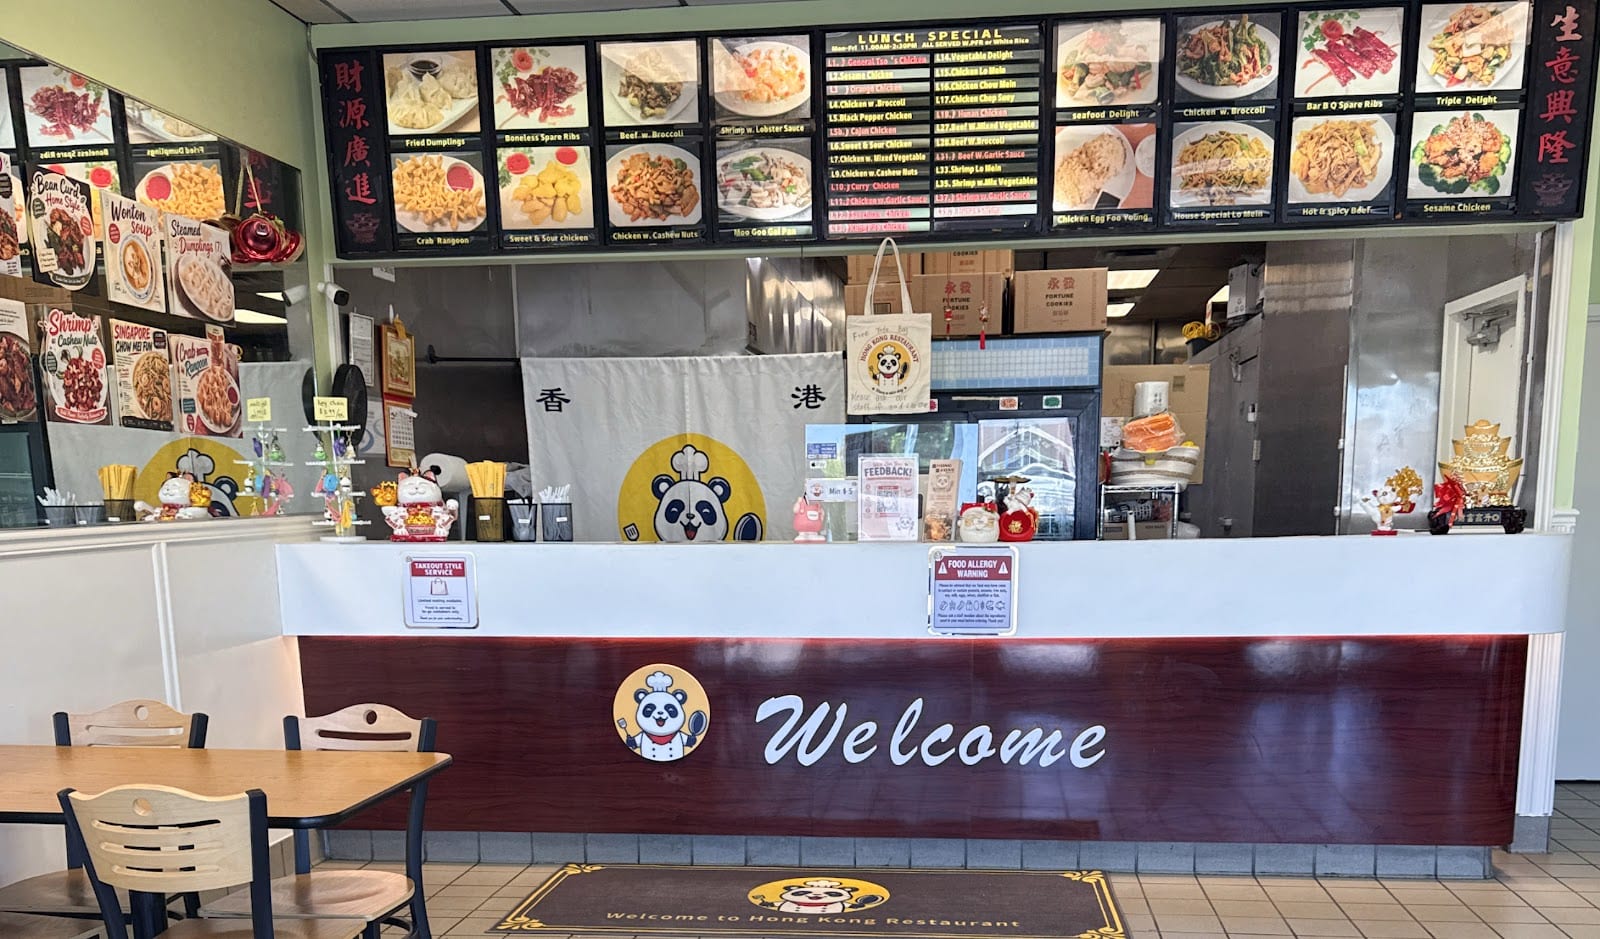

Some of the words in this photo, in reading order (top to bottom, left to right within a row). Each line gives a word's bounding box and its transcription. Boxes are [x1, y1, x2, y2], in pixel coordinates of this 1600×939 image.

[858, 33, 914, 44] LUNCH
[928, 29, 1002, 41] SPECIAL
[987, 50, 1014, 60] Delight
[867, 70, 894, 78] Chicken
[980, 67, 988, 75] Lo
[989, 66, 1007, 74] Mein
[979, 80, 999, 88] Chow
[999, 80, 1017, 88] Mein
[1537, 5, 1583, 164] 生意興隆
[1306, 102, 1321, 110] Bar
[1322, 102, 1329, 110] B
[1330, 102, 1337, 110] Q
[1338, 101, 1363, 110] Spare
[1364, 100, 1384, 108] Ribs
[1436, 97, 1462, 106] Triple
[1465, 95, 1497, 105] Delight
[829, 113, 859, 122] L5.Black
[859, 114, 885, 122] Pepper
[885, 111, 913, 120] Chicken
[1072, 111, 1106, 120] seafood
[1109, 110, 1140, 119] Delight
[1183, 108, 1216, 117] Chicken
[1231, 105, 1266, 115] Broccoli
[334, 59, 377, 205] 財源廣進
[619, 131, 638, 139] Beef
[651, 130, 684, 139] Broccoli
[720, 126, 745, 135] Shrimp
[755, 125, 784, 133] Lobster
[405, 139, 425, 147] Fried
[426, 138, 466, 147] Dumplings
[505, 134, 539, 142] Boneless
[540, 134, 562, 143] Spare
[830, 155, 865, 163] L7.Chicken
[893, 153, 926, 162] Vegetable
[831, 170, 868, 178] L9.Chicken
[868, 169, 902, 177] w.Cashew
[902, 168, 918, 176] Nuts
[935, 165, 975, 174] L33.Shrimp
[985, 164, 1002, 172] Mein
[35, 174, 58, 194] Bean
[59, 182, 81, 198] Curd
[851, 183, 870, 192] Curry
[872, 182, 900, 190] Chicken
[45, 195, 64, 206] Home
[64, 197, 81, 211] Style
[1423, 204, 1456, 213] Sesame
[1457, 203, 1491, 211] Chicken
[111, 201, 146, 222] Wonton
[1174, 212, 1200, 220] House
[1201, 211, 1230, 220] Special
[1243, 210, 1264, 218] Mein
[1302, 208, 1318, 216] Hot
[1319, 207, 1326, 215] &
[1327, 207, 1350, 216] spicy
[1351, 206, 1371, 214] Beef
[1057, 214, 1089, 224] Chicken
[1090, 214, 1105, 224] Egg
[1106, 214, 1122, 222] Foo
[1123, 213, 1149, 223] Young
[131, 221, 153, 241] soup
[171, 219, 201, 237] Steamed
[733, 228, 750, 237] Moo
[751, 228, 767, 236] Goo
[767, 227, 781, 236] Gai
[509, 235, 533, 243] Sweet
[541, 234, 559, 242] Sour
[559, 234, 589, 242] chicken
[612, 232, 642, 240] Chicken
[642, 232, 652, 240] w.
[652, 231, 681, 239] Cashew
[681, 230, 699, 239] Nuts
[179, 236, 214, 258] Dumplings
[416, 237, 434, 245] Crab
[437, 237, 470, 246] Rangoon
[49, 310, 92, 336] Shrimp
[114, 325, 150, 340] SINGAPORE
[57, 335, 82, 347] Cashew
[83, 336, 98, 346] Nuts
[115, 340, 132, 352] CHOW
[132, 340, 142, 351] MEI
[142, 341, 153, 351] FUN
[179, 343, 196, 362] Crab
[860, 344, 873, 362] HONG
[872, 334, 888, 345] KONG
[890, 335, 919, 363] RESTAURANT
[185, 358, 209, 377] Rangoon
[536, 387, 571, 413] 香
[791, 384, 826, 409] 港
[864, 466, 912, 477] FEEDBACK!
[842, 487, 847, 495] $
[948, 560, 966, 568] FOOD
[967, 560, 998, 569] ALLERGY
[755, 694, 1106, 769] Welcome
[606, 912, 708, 922] Welcome
[717, 914, 740, 922] to
[749, 915, 809, 924] Hong
[818, 916, 877, 925] Kong
[886, 917, 1020, 928] Restaurant
